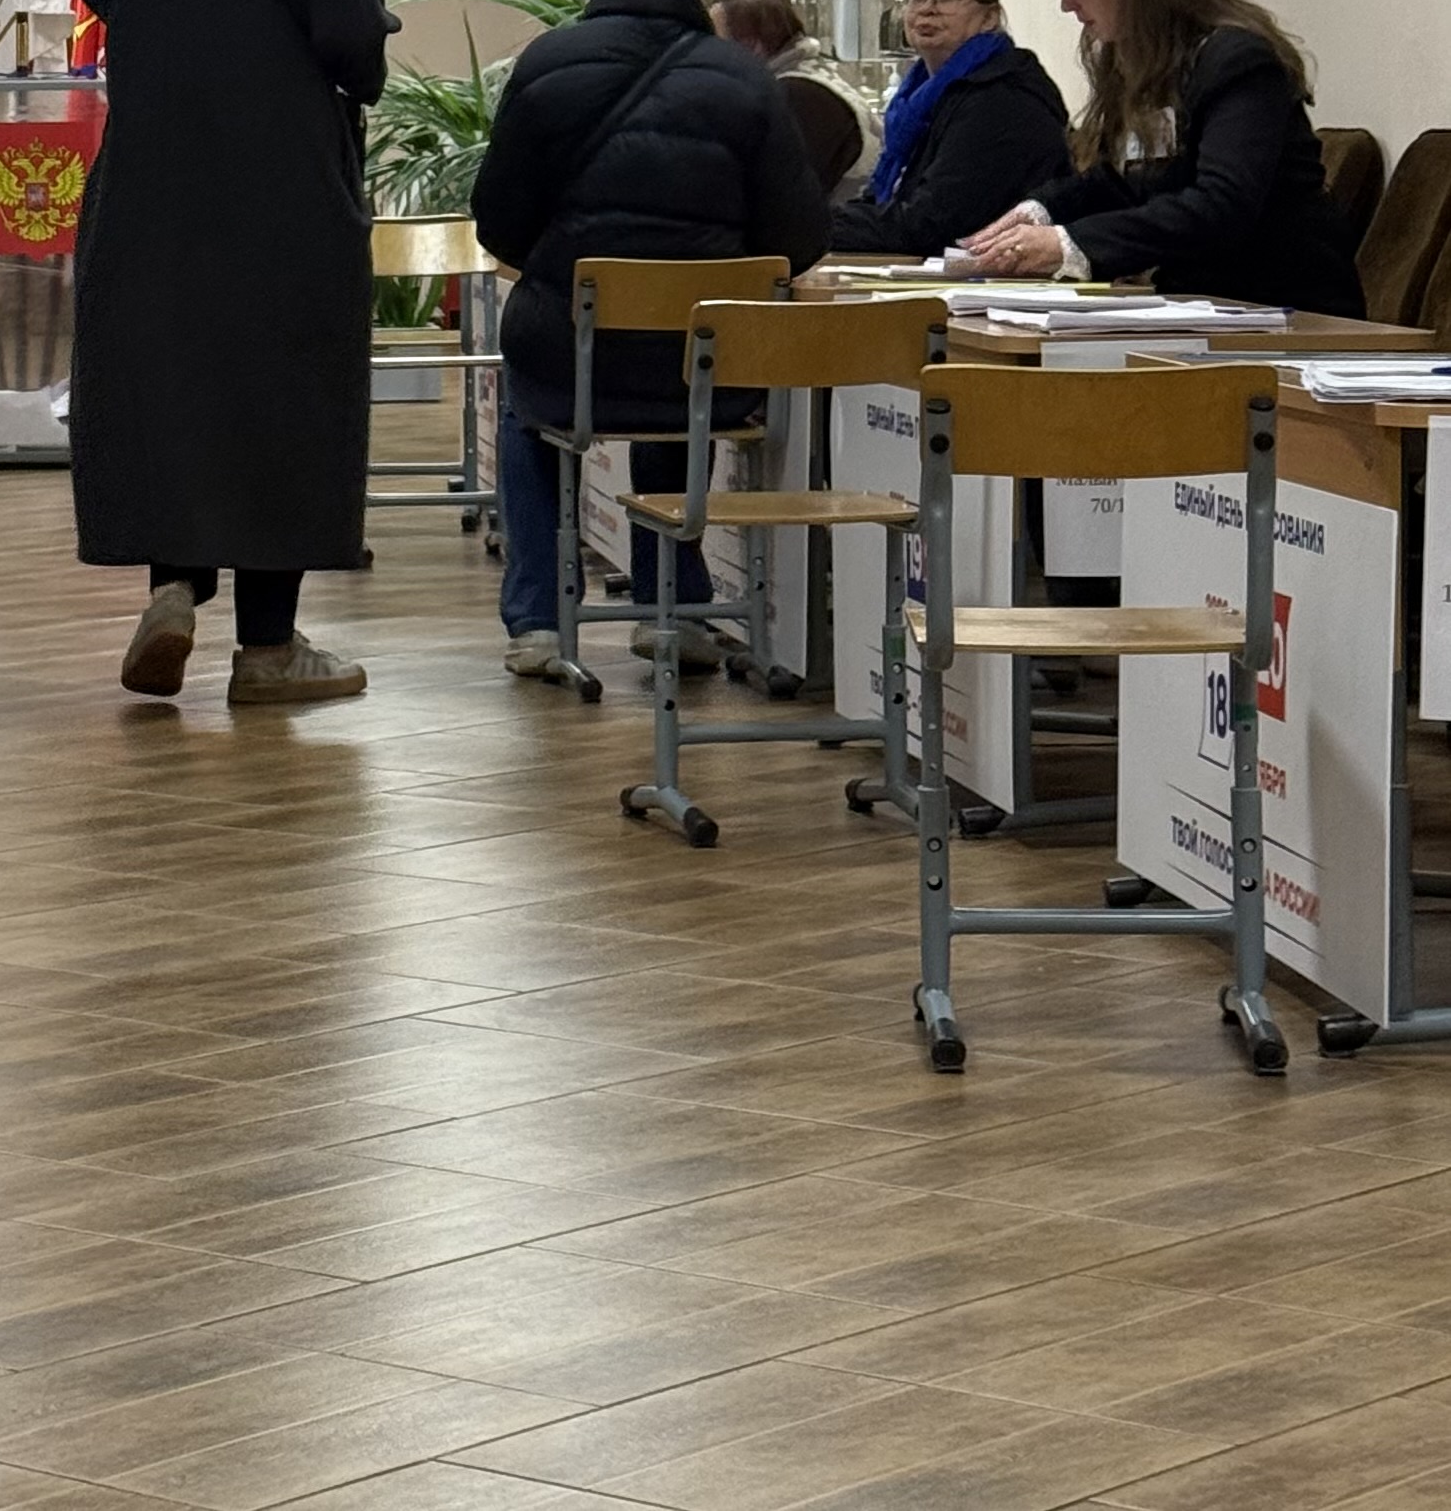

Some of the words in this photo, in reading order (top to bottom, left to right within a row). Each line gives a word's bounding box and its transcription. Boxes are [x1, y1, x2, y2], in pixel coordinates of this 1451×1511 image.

[1090, 497, 1124, 514] 70/1
[1174, 481, 1216, 521] ЕДИНЫЙ
[1216, 494, 1244, 529] ДЕНЬ
[907, 532, 922, 582] 19
[1207, 670, 1228, 738] 18
[1170, 815, 1199, 857] ТВОЙ
[1199, 829, 1234, 875] ГОЛОС
[1273, 870, 1321, 928] РОССИИ
